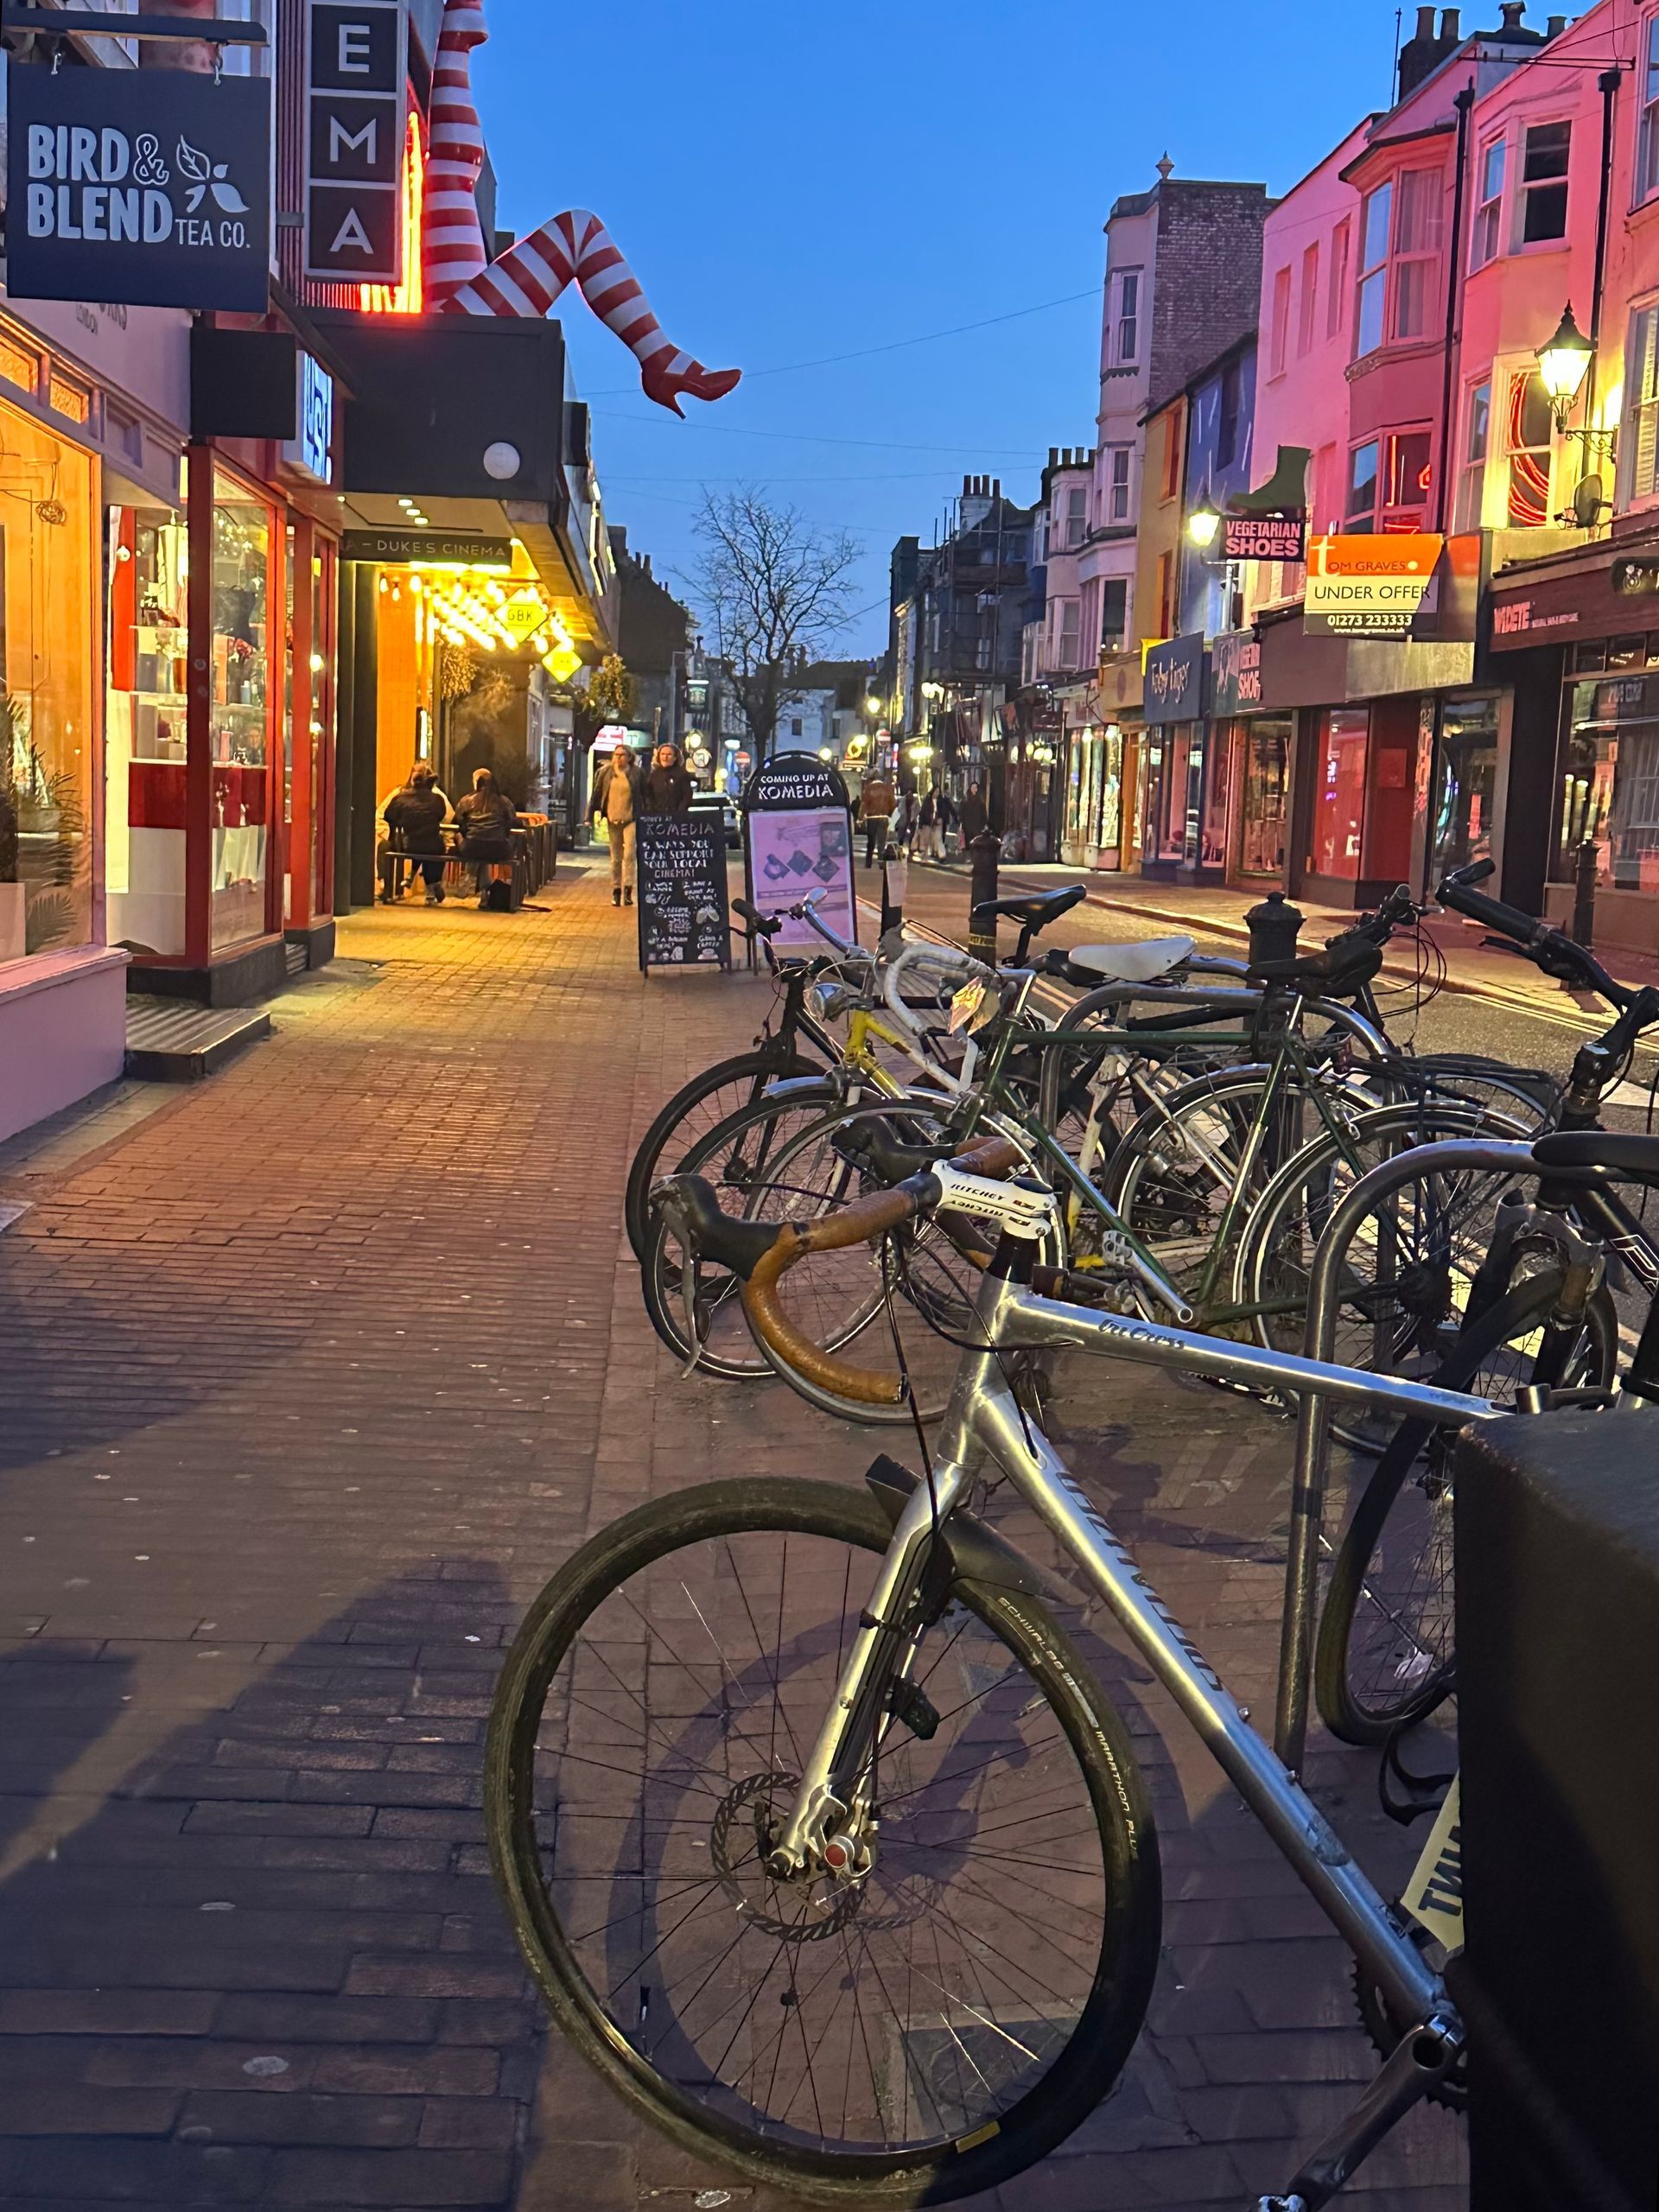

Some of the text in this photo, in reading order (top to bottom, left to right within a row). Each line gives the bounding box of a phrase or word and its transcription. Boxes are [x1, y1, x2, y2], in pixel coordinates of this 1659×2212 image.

[28, 124, 130, 181] BIRD
[27, 182, 173, 243] BLEND
[175, 218, 251, 249] TEA CO.
[1225, 520, 1300, 538] VEGETARIAN
[377, 539, 436, 554] DUKE'S
[442, 543, 506, 557] CINEMA
[1225, 537, 1300, 557] SHOES
[1356, 561, 1407, 572] GRAVES
[1314, 585, 1431, 601] UNDER OFFER
[506, 607, 534, 622] GBK
[1326, 614, 1413, 626] 01273 233333
[760, 775, 800, 785] COMING
[817, 773, 830, 782] AT
[758, 784, 835, 800] KOMEDIA
[646, 823, 715, 836] KOMEDIA
[950, 1183, 1006, 1201] RITCHEY
